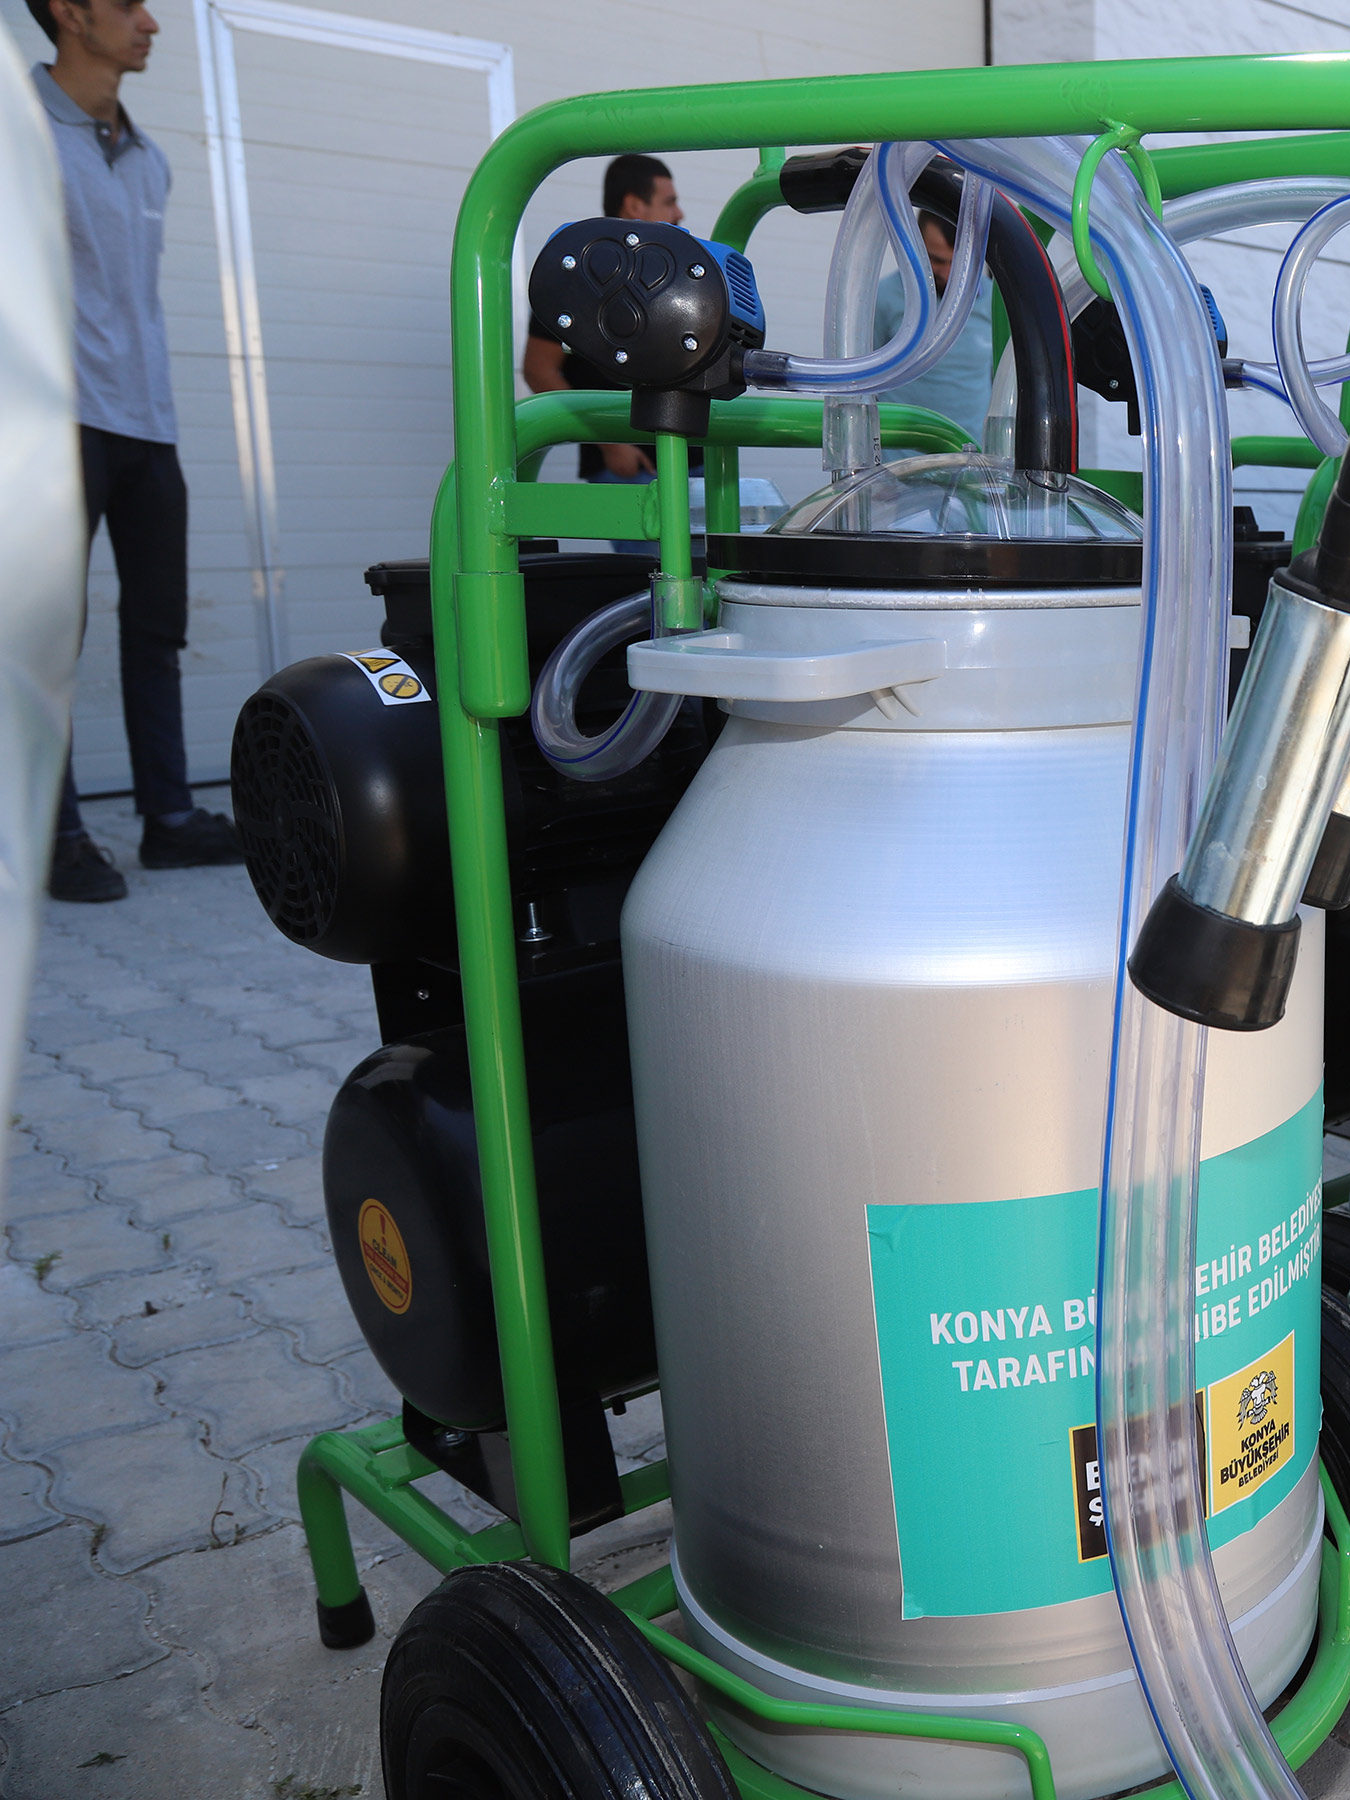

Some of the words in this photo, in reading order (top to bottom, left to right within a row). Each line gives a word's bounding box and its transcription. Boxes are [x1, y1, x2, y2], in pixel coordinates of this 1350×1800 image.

[372, 1239, 398, 1269] CLEAN
[929, 1304, 1053, 1345] KONYA
[1258, 1168, 1322, 1267] BELEDİYESİ
[951, 1345, 1096, 1392] TARAFIN
[1248, 1222, 1321, 1318] EDİLMİŞTİR
[1220, 1422, 1290, 1485] BÜYÜKŞEHİR
[1241, 1419, 1276, 1453] KONYA
[1238, 1449, 1279, 1488] BELEDİYESİ
